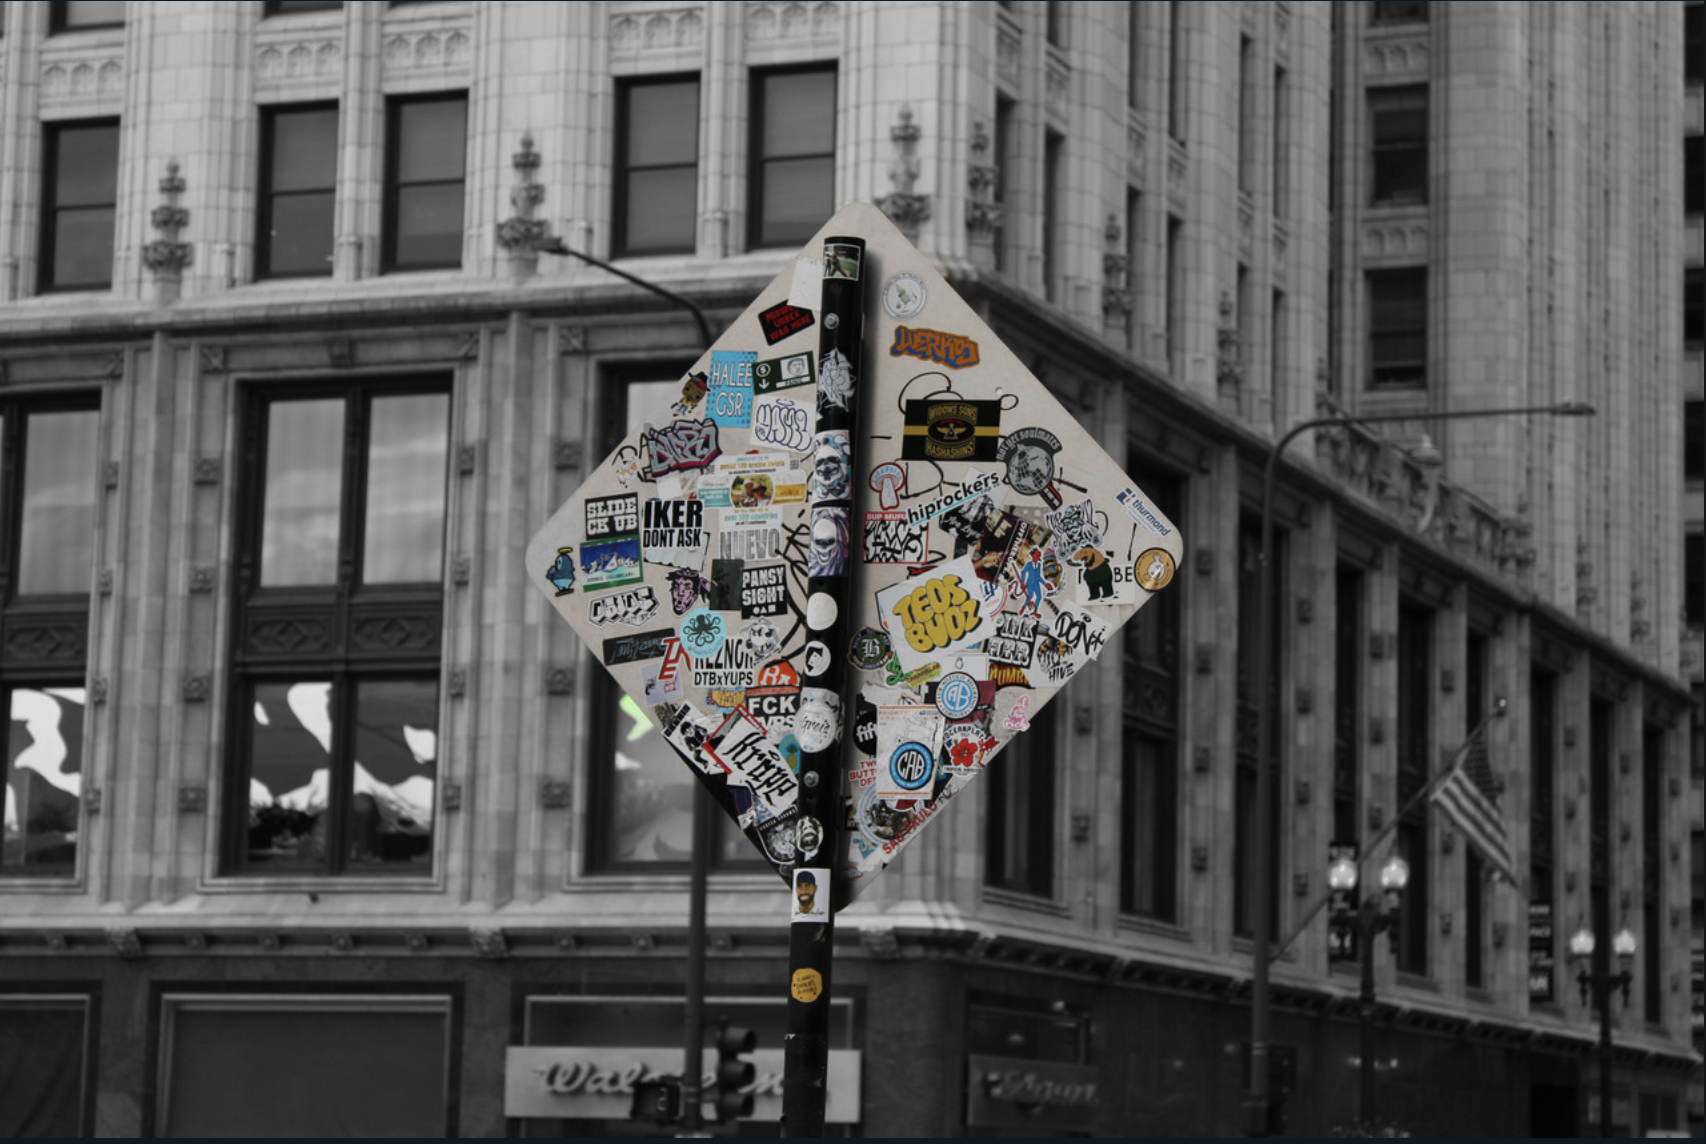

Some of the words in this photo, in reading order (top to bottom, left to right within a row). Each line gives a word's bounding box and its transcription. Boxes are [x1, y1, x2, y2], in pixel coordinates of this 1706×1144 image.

[907, 470, 1000, 524] hiprockers
[644, 500, 703, 528] IKER
[884, 513, 907, 521] MUFU
[1132, 499, 1171, 536] thurmond
[643, 529, 675, 548] DONT
[676, 529, 701, 547] ASK
[720, 528, 780, 560] NUEVO
[742, 567, 784, 588] PANSY
[742, 585, 785, 606] SIGHT
[694, 671, 753, 686] DTBxYUPS
[748, 695, 796, 715] FCK
[856, 721, 877, 743] fif
[849, 768, 876, 780] BUTT
[860, 761, 876, 769] TW
